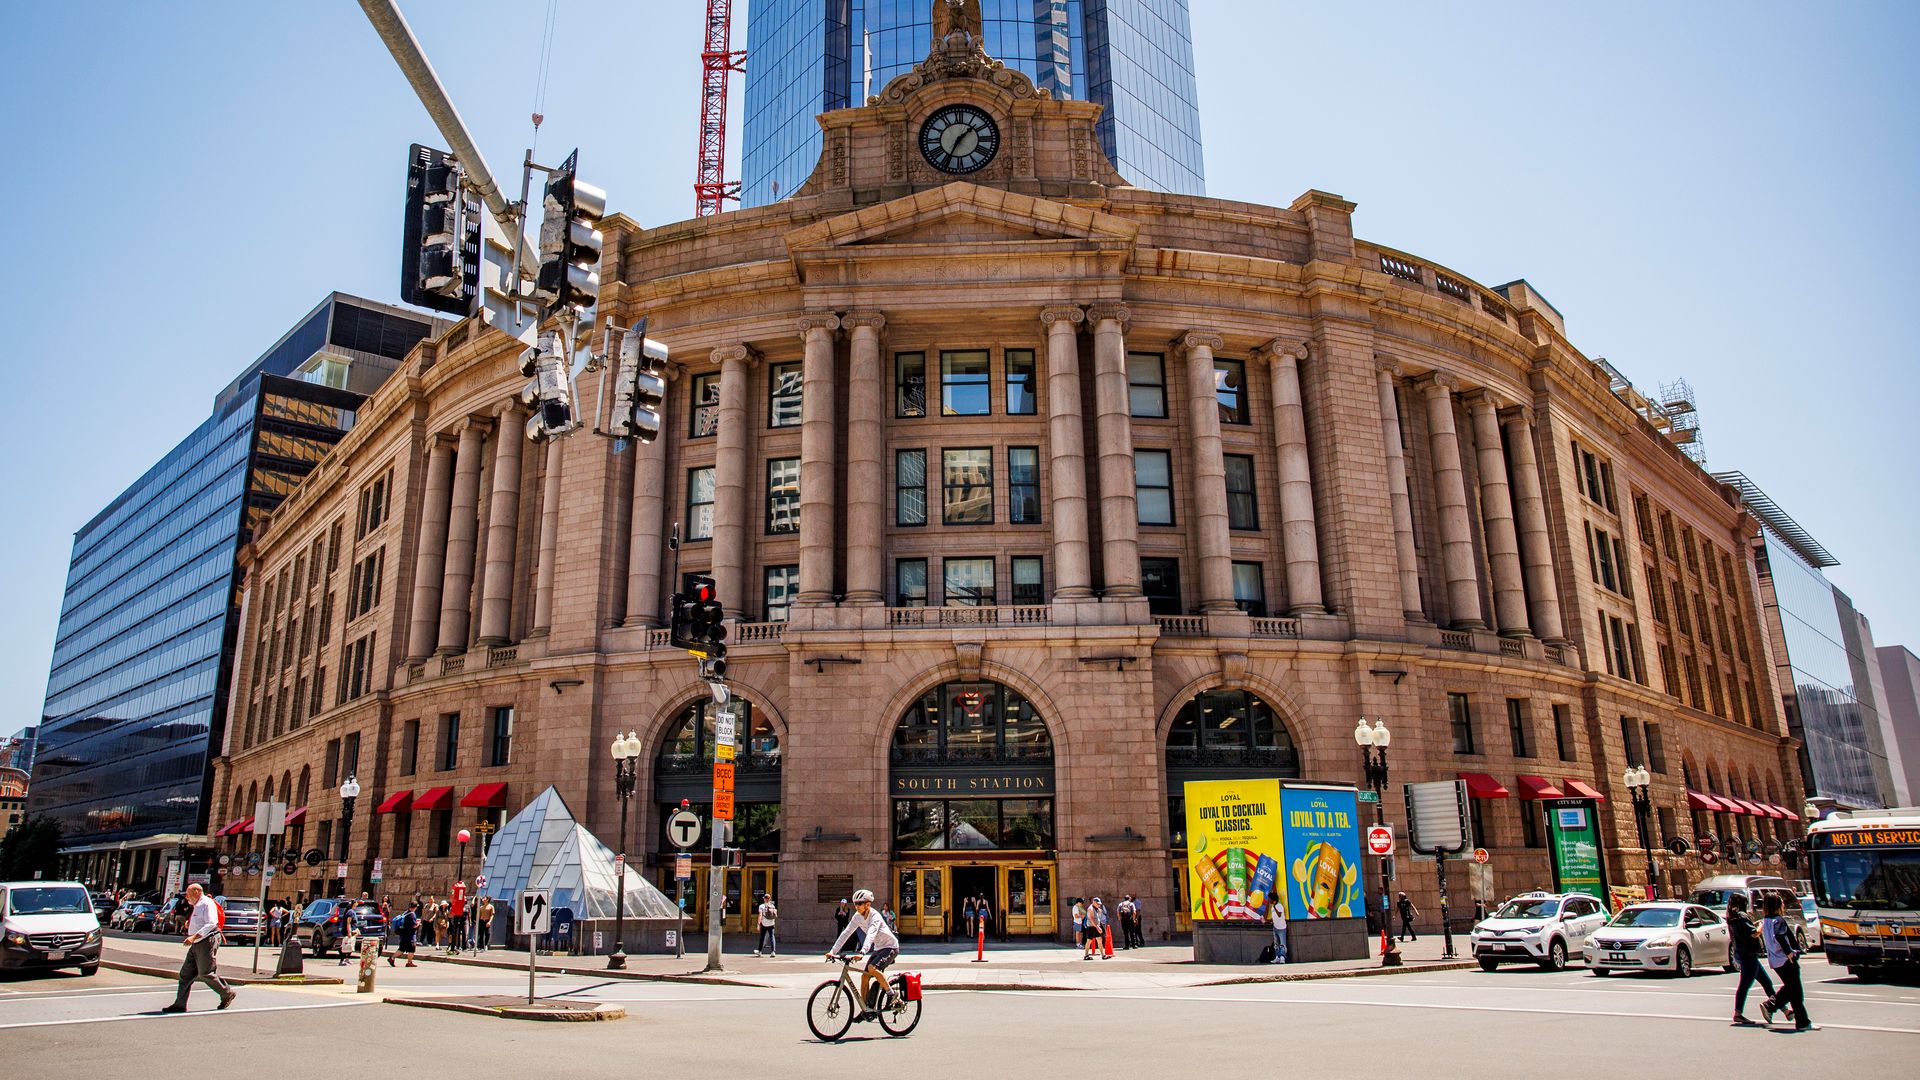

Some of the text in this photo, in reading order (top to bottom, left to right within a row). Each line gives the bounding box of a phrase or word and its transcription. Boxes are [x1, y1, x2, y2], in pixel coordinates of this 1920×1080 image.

[717, 716, 734, 725] DO NOT
[718, 726, 733, 735] BLOCK
[716, 768, 732, 779] BCEC
[898, 777, 1045, 789] SOUTH STATION
[1199, 803, 1267, 819] LOYAL TO COCKTAIL
[1215, 818, 1253, 832] CLASSICS.
[1290, 811, 1352, 829] LOYAL TO A TEA.
[675, 821, 696, 842] T
[1831, 833, 1853, 845] NOT
[1858, 832, 1873, 844] IN
[1202, 866, 1216, 882] LOYAL
[1257, 867, 1273, 882] LOYAL
[1319, 862, 1337, 878] LOYAL
